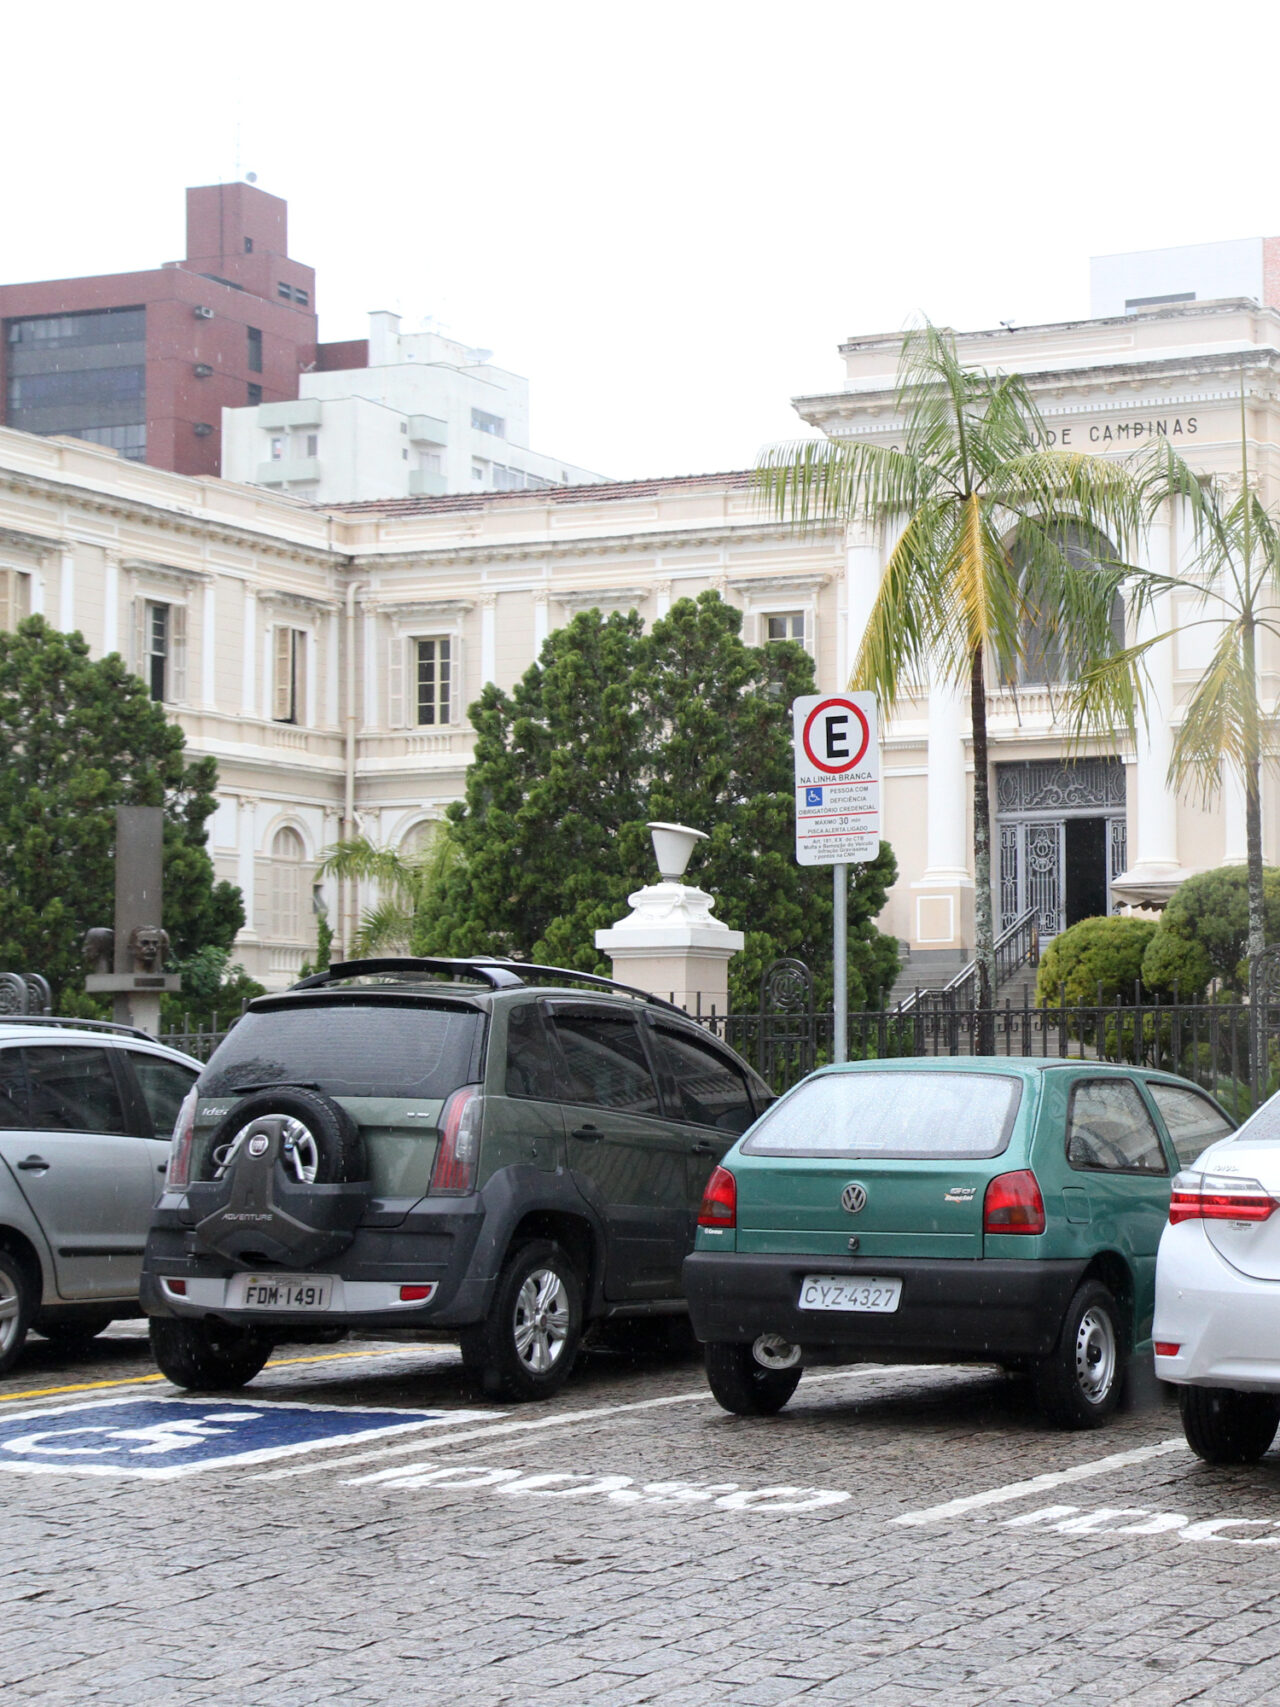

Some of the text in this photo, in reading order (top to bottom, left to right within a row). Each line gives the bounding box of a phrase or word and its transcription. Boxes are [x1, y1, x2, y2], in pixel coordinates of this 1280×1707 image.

[1089, 417, 1198, 442] CAMPINAS
[825, 715, 850, 758] E
[813, 775, 837, 783] LINHA
[838, 772, 873, 782] BRANCA
[839, 804, 876, 813] CREDENCIAL
[838, 817, 849, 825] 30
[221, 1213, 273, 1221] ADVENTURE
[337, 1463, 853, 1512] IDOSO
